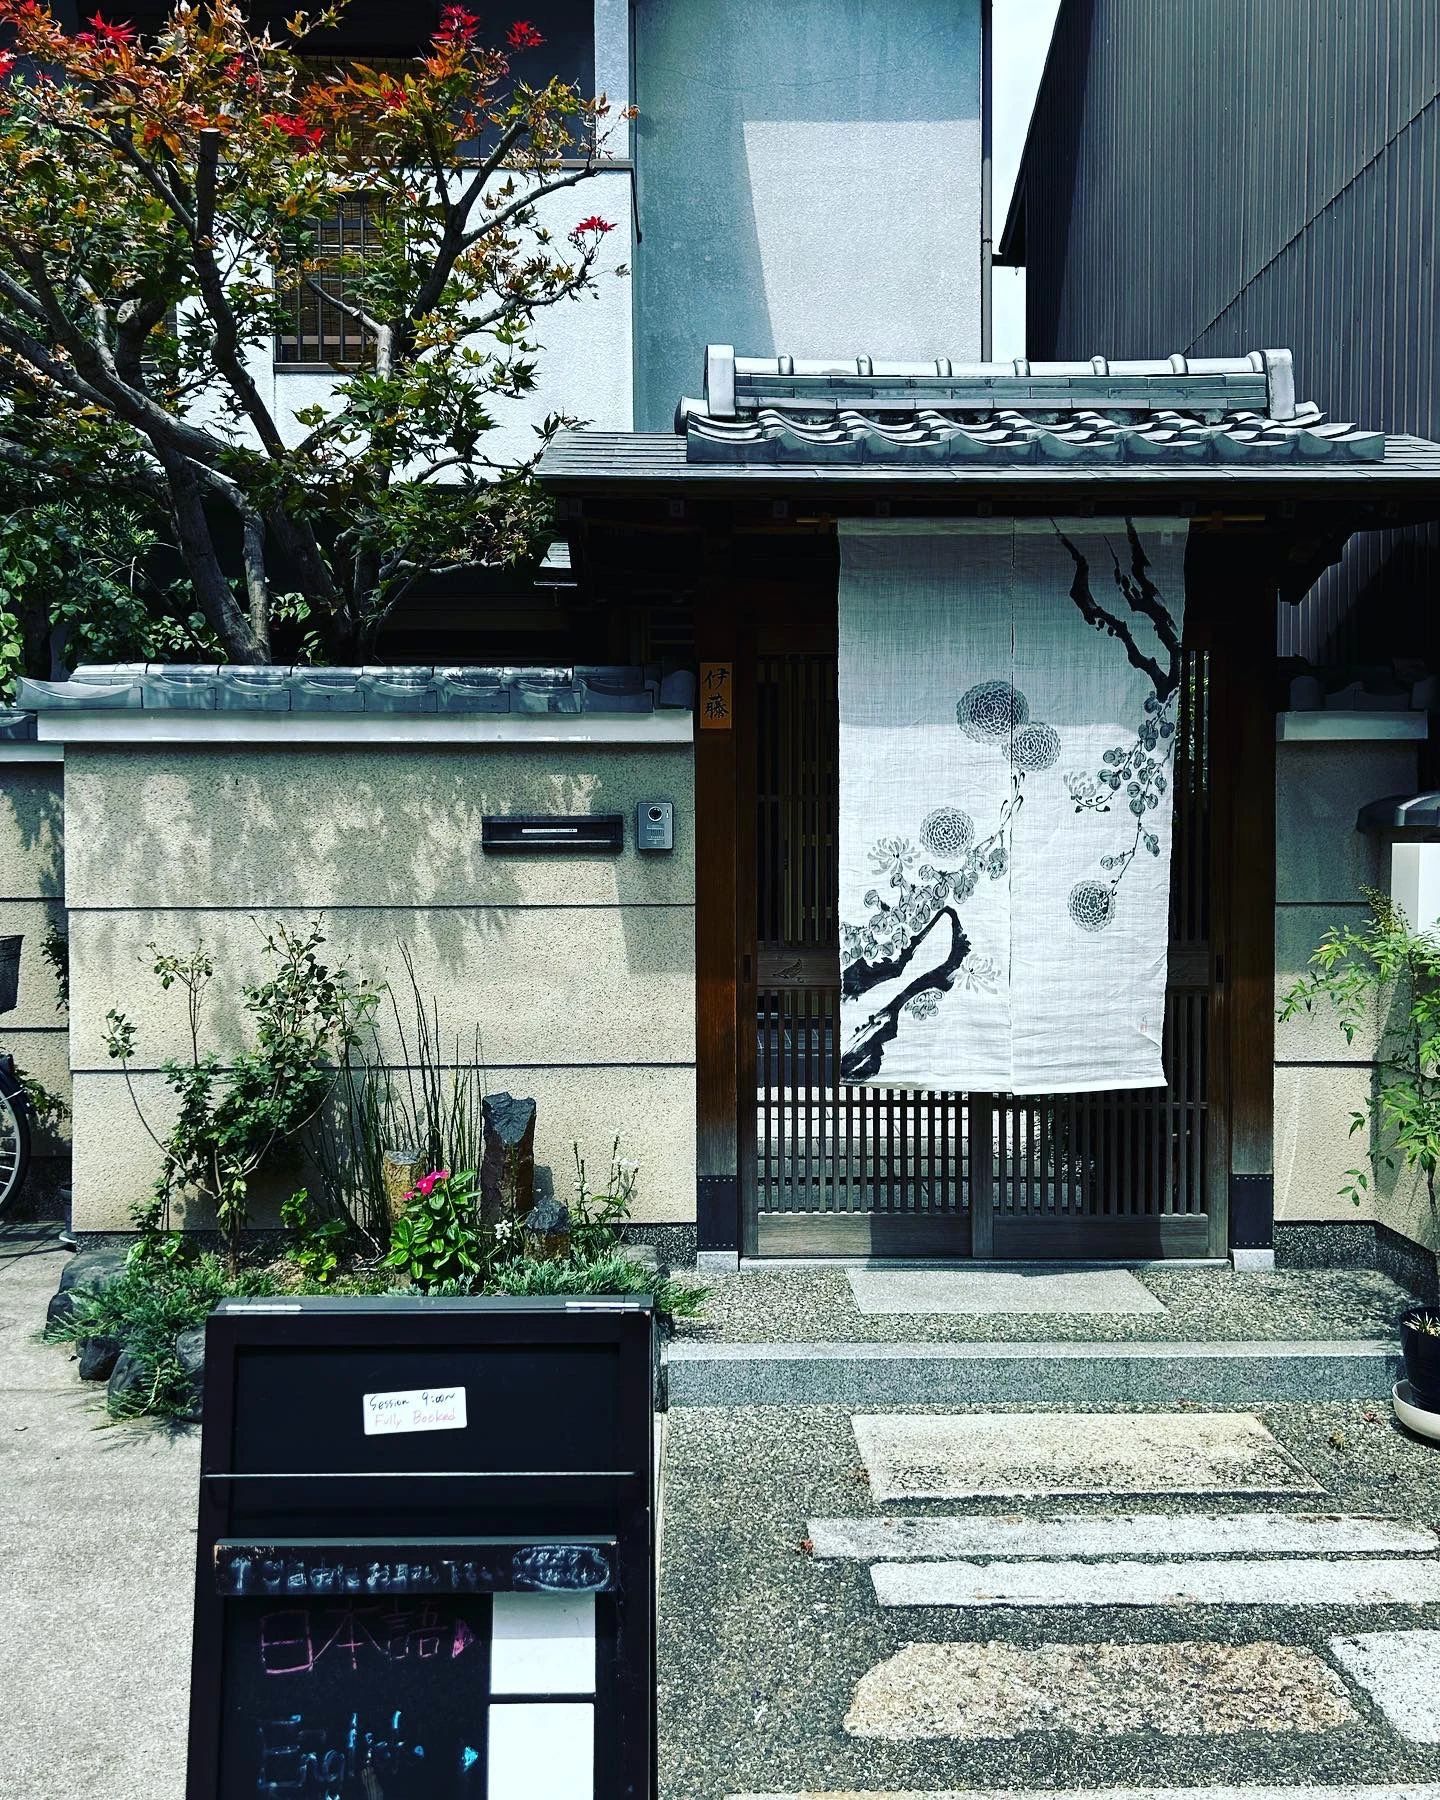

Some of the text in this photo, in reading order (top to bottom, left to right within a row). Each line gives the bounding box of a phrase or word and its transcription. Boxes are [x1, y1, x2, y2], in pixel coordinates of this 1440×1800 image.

[704, 667, 730, 721] 伊藤
[369, 1395, 410, 1411] Session
[375, 1408, 456, 1429] Fully Booked
[260, 1598, 449, 1675] 日本語
